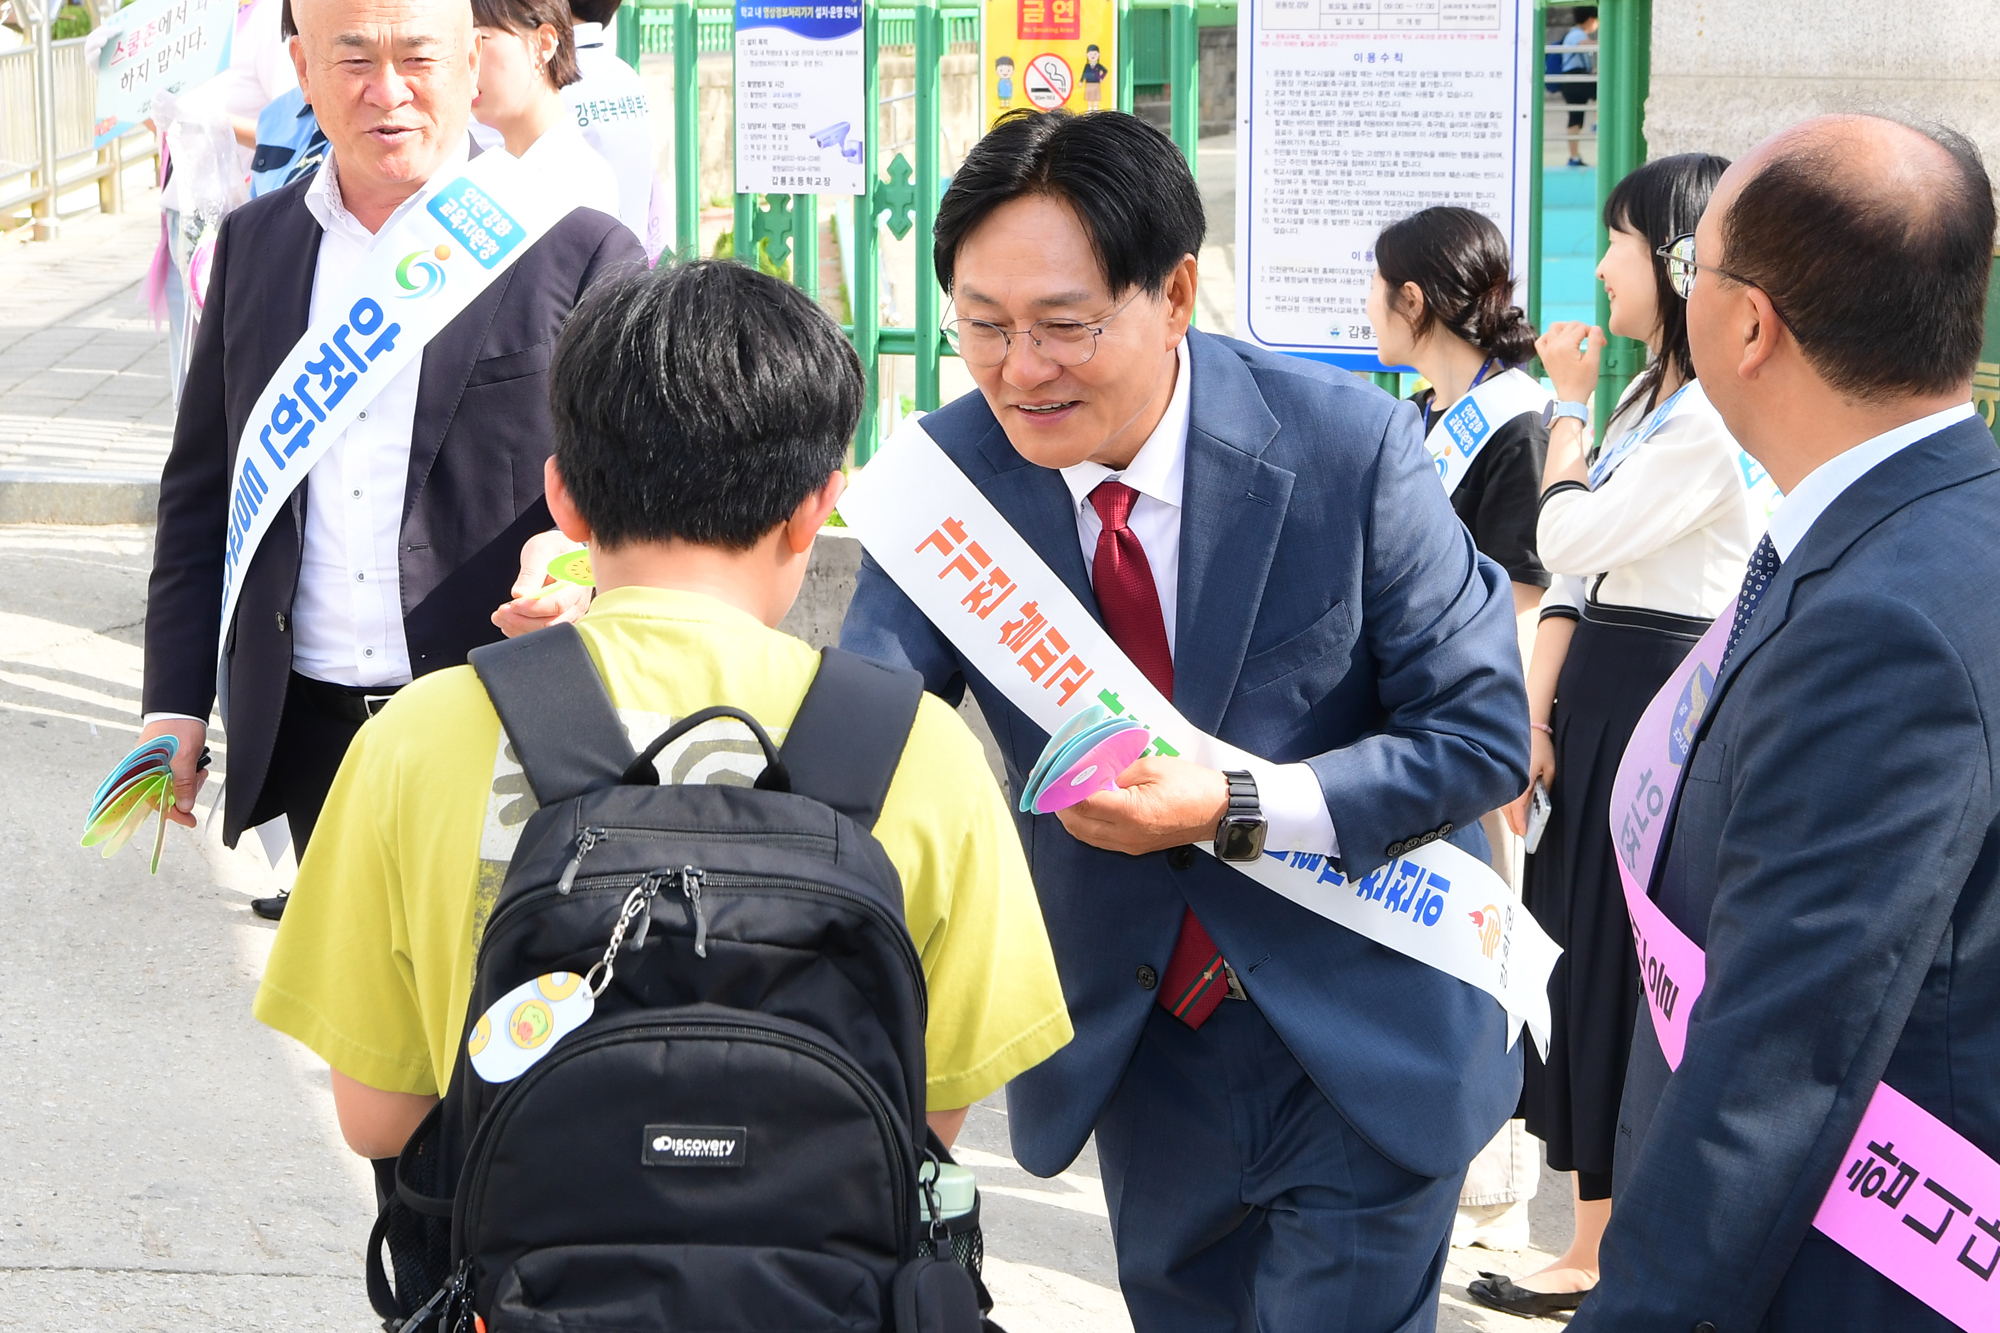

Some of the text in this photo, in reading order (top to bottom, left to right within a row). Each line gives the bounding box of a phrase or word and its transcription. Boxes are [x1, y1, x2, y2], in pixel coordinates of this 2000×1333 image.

[120, 58, 149, 92] 하지
[438, 197, 500, 260] 교육지원청
[460, 187, 514, 238] 인천강화
[259, 297, 402, 471] 안전한
[1448, 413, 1475, 452] 교육지원청
[1460, 403, 1485, 434] 인천강화
[914, 516, 1096, 708] 가기전 살피고
[653, 1135, 736, 1157] Discovery
[1846, 1140, 2000, 1283] 합니다
